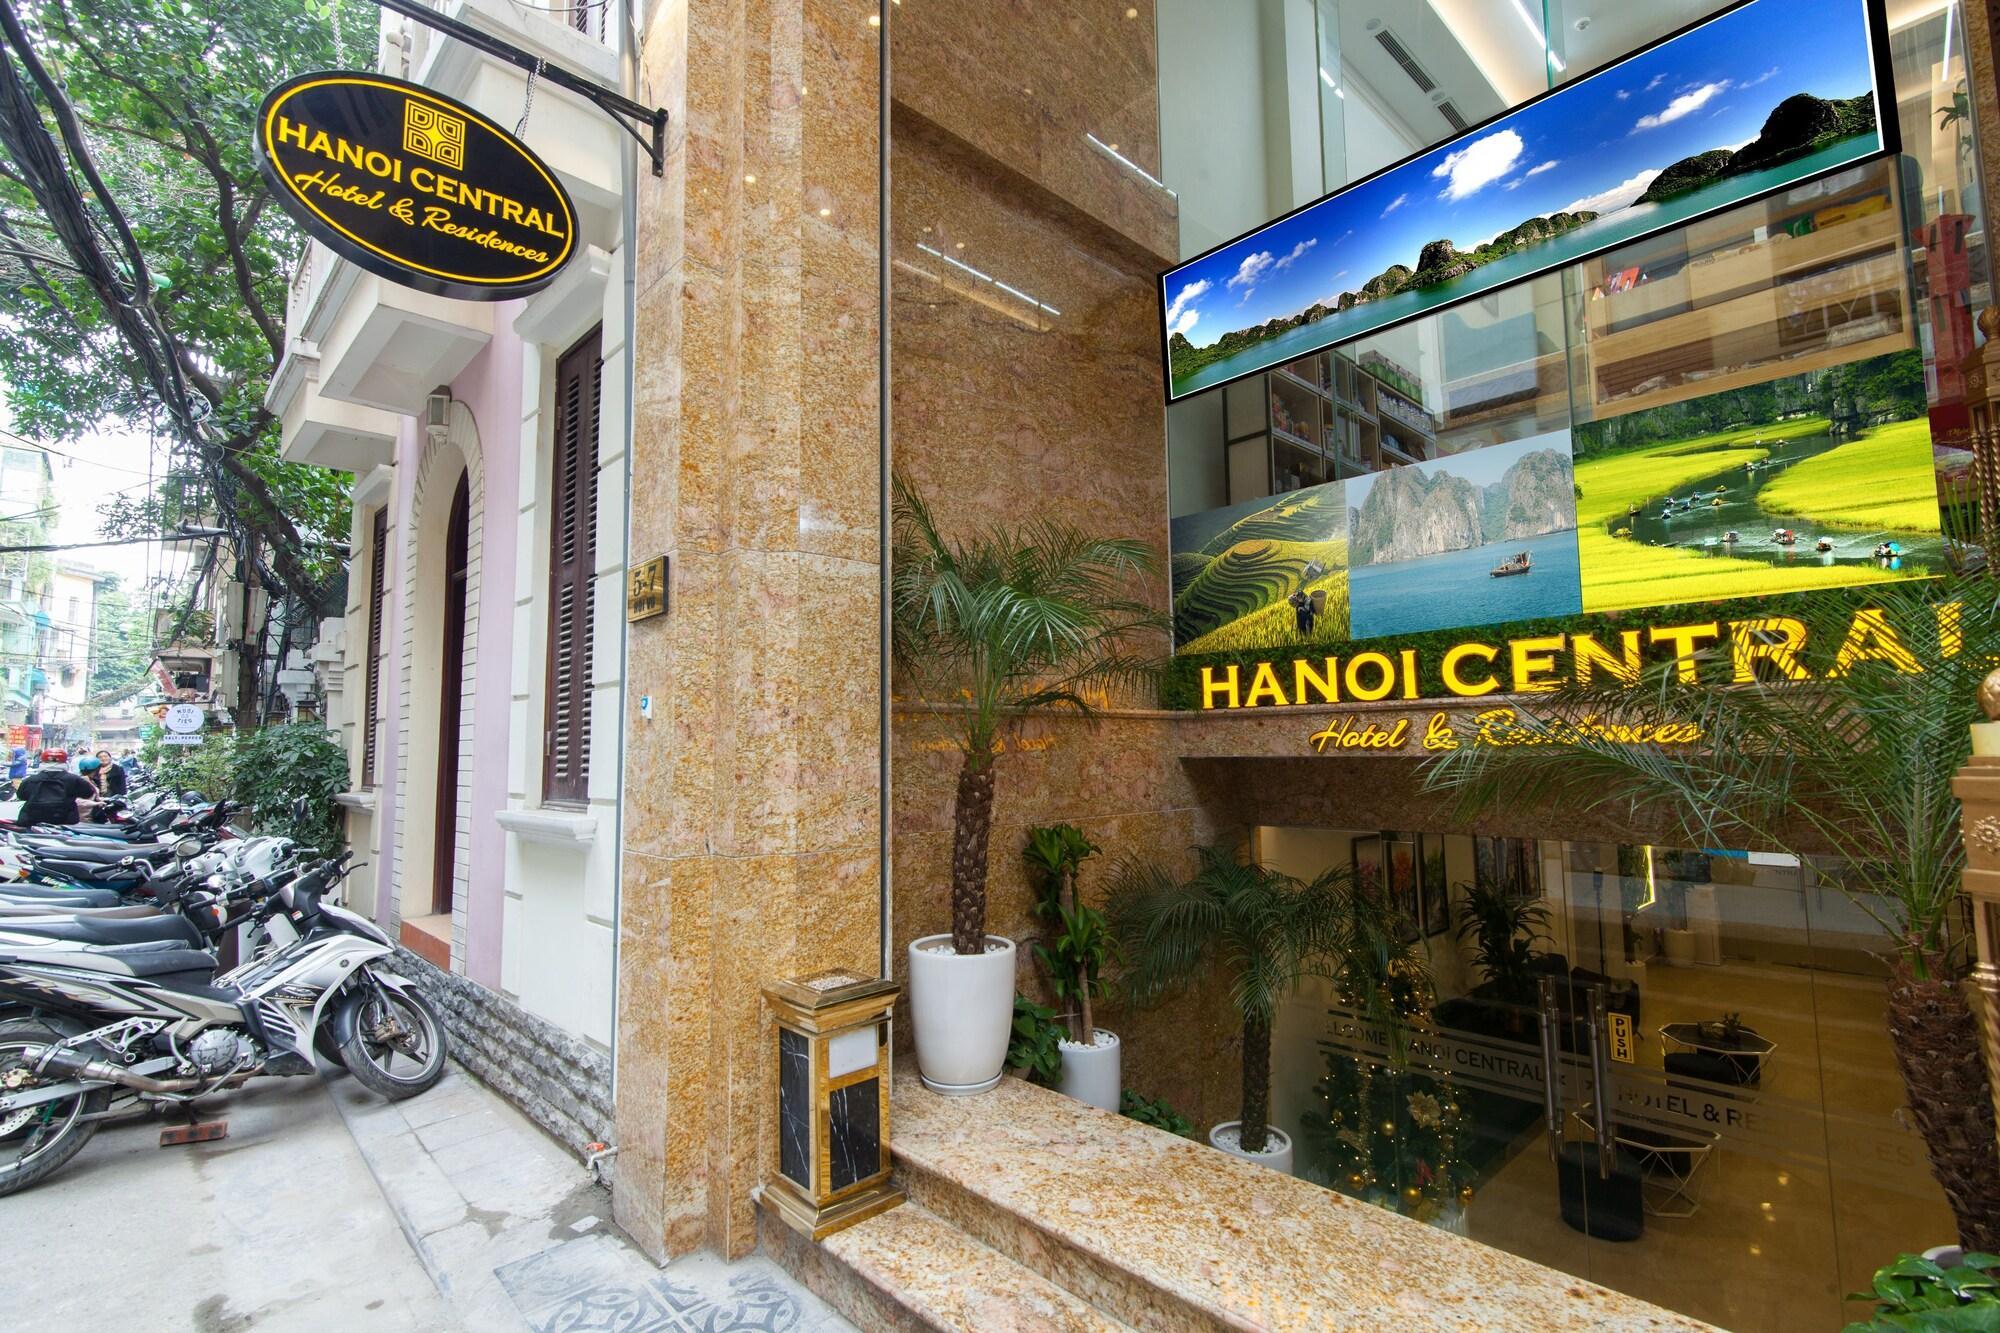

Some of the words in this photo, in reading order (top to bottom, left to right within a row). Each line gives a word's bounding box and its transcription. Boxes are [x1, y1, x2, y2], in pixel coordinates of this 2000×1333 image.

[277, 116, 403, 183] HANOI
[410, 167, 565, 239] CENTRAL
[295, 170, 385, 209] Hotel
[388, 198, 414, 226] &
[421, 206, 549, 263] Residences
[1201, 649, 1419, 709] HANOI
[1309, 715, 1408, 752] Hotel
[1422, 712, 1459, 750] &
[1615, 1017, 1628, 1059] PUSH
[1402, 1038, 1451, 1060] ANOI
[1455, 1048, 1544, 1083] CENTRAL
[1703, 1103, 1721, 1123] &
